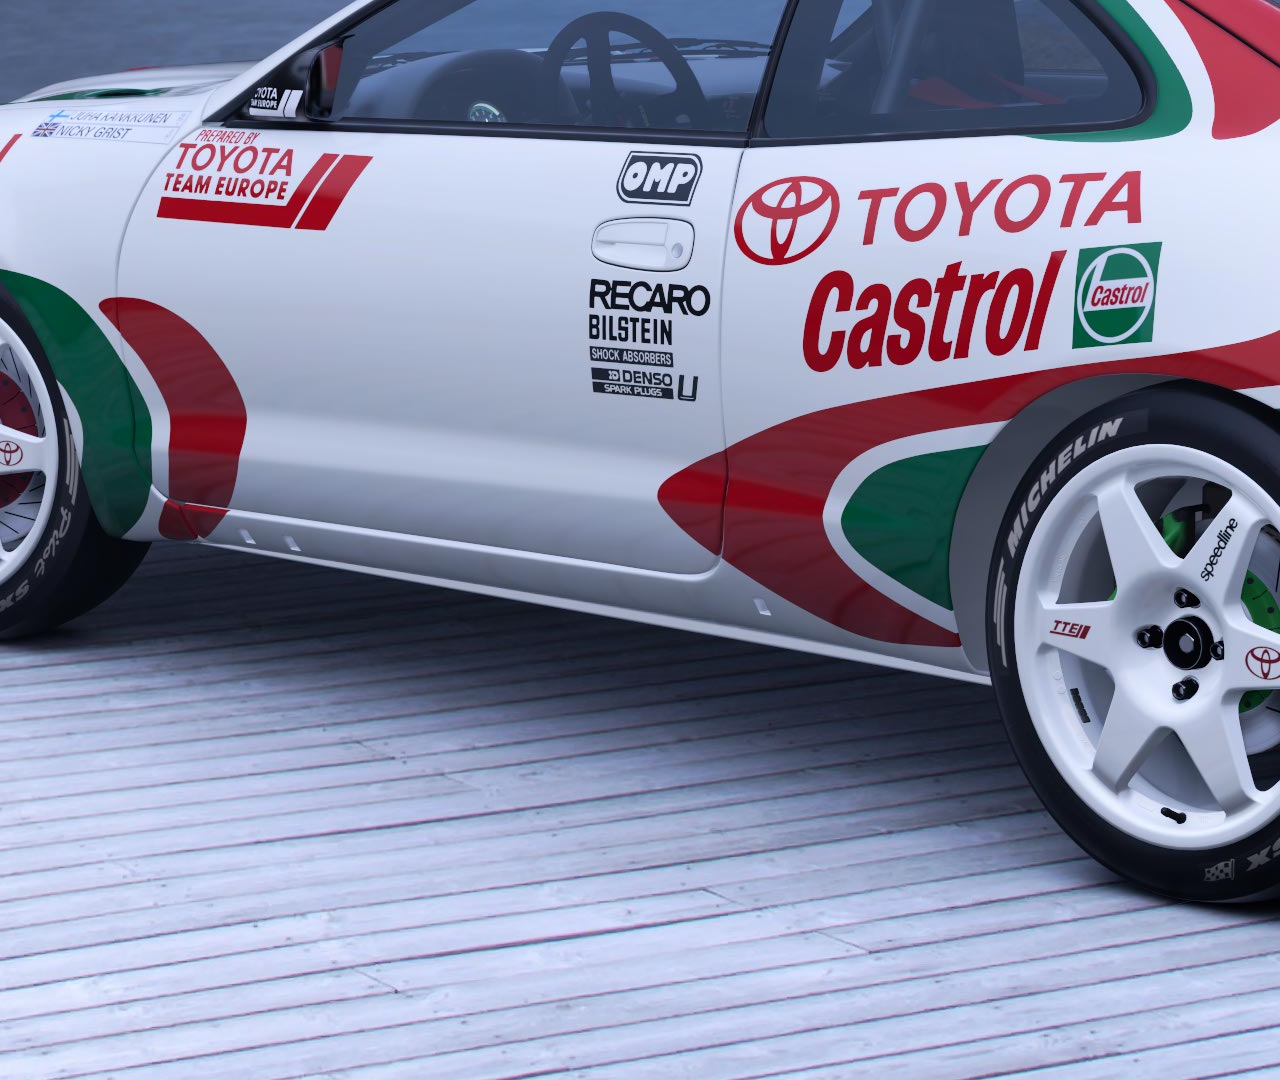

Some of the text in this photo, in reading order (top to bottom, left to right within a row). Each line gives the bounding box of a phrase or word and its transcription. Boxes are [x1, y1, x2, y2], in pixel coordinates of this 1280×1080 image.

[56, 125, 133, 139] NICKY GRIST
[70, 111, 102, 121] JUHA
[195, 129, 261, 145] PREPARED BY
[175, 143, 294, 177] TOYOTA
[623, 158, 693, 194] OMP
[164, 173, 289, 200] TEAM EUROPE
[857, 170, 1142, 246] TOYOTA
[589, 278, 711, 317] RECARO
[1089, 281, 1150, 307] Castrol
[801, 249, 1067, 373] Castrol
[589, 314, 673, 346] BILSTEIN
[591, 347, 672, 365] SHOCK ABSORBERS
[604, 384, 663, 397] SPARK PLUGS
[622, 369, 673, 387] DENSO
[1007, 417, 1124, 559] MICHELIN
[34, 506, 72, 578] Pilot
[1200, 517, 1239, 583] speedline
